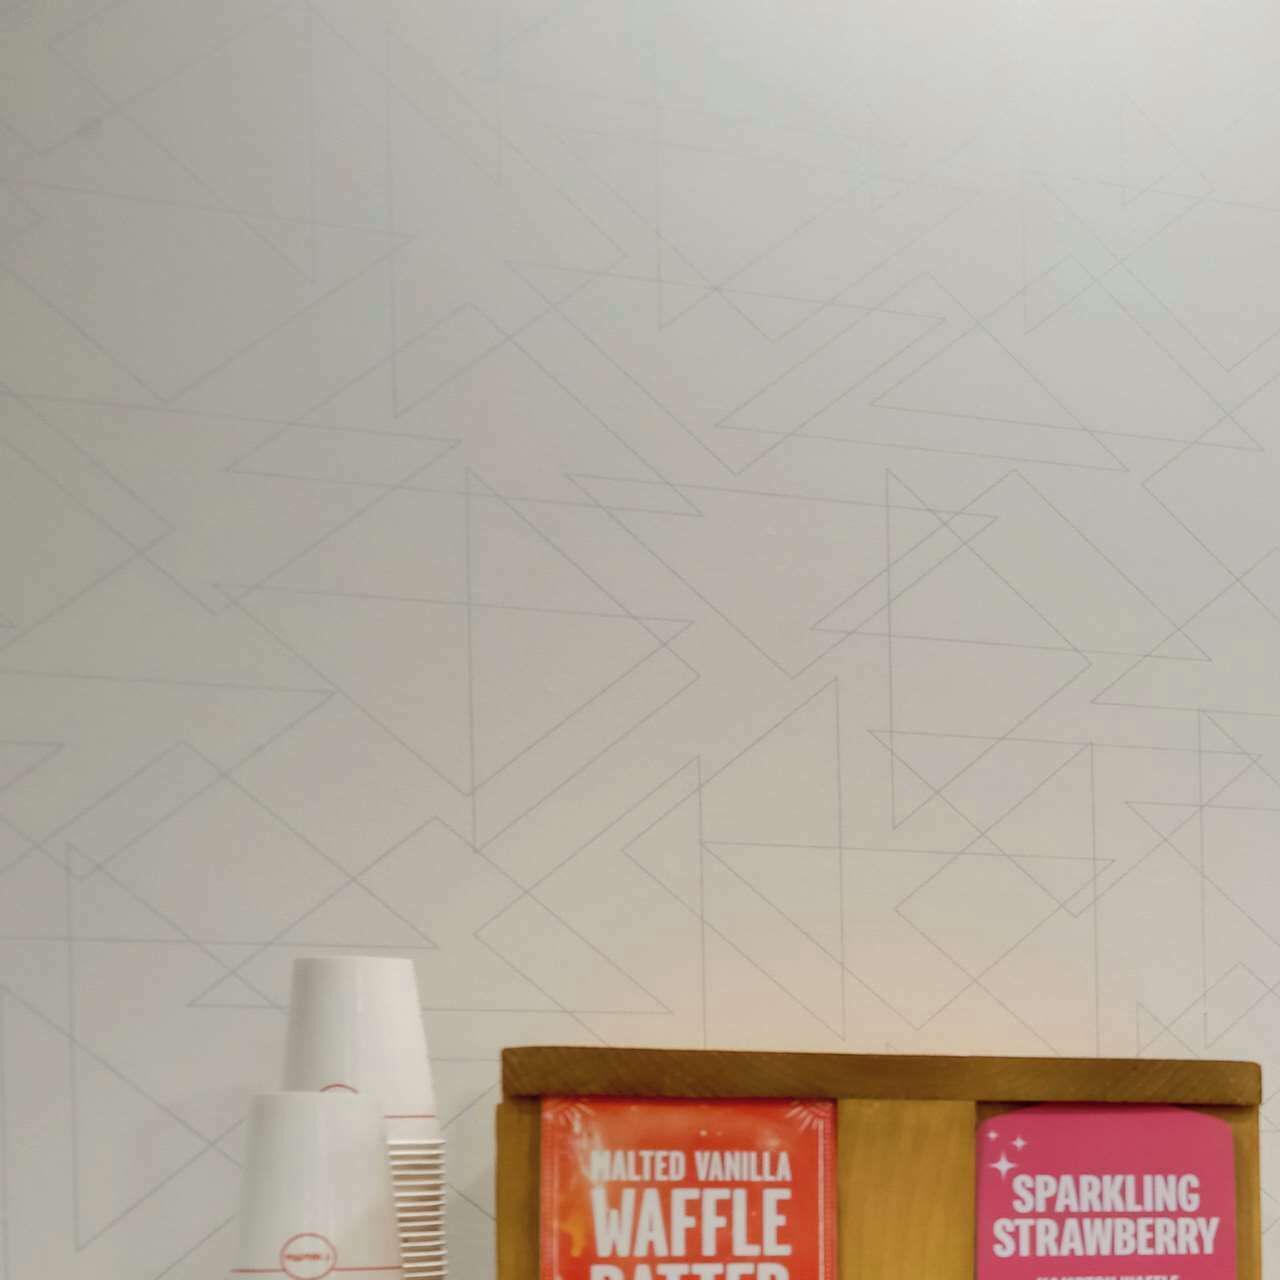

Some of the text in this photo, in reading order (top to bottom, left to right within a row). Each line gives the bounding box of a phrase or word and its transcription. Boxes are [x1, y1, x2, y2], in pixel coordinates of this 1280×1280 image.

[591, 1149, 793, 1182] MALTED VANILLA
[1011, 1174, 1200, 1213] SPARKLING
[589, 1188, 793, 1258] WAFFLE
[992, 1217, 1220, 1258] STRAWBERRY
